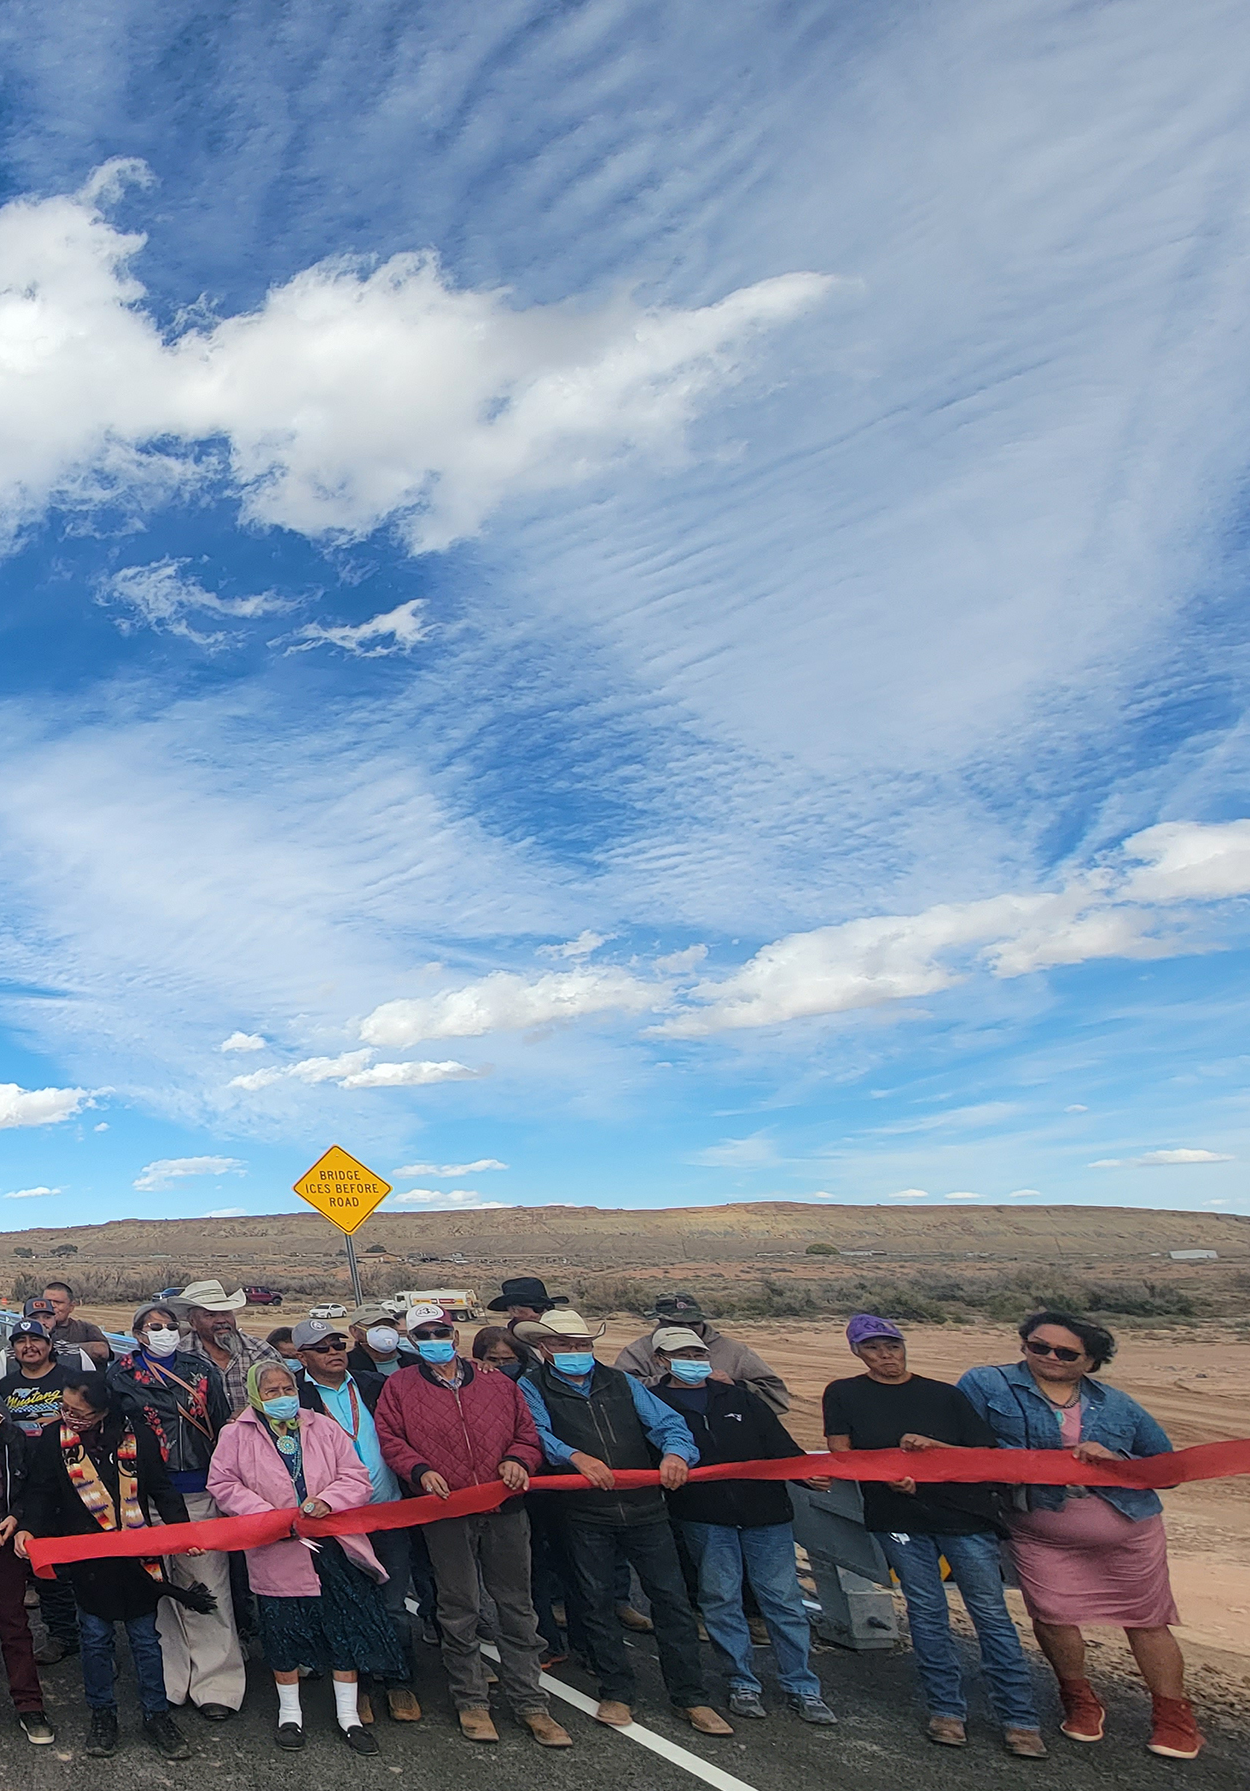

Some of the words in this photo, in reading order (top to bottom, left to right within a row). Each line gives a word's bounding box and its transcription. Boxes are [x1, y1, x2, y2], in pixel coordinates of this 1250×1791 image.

[319, 1170, 361, 1181] BRIDGE
[305, 1183, 331, 1194] ICES
[335, 1183, 379, 1194] BEFORE
[329, 1197, 359, 1207] ROAD
[5, 1389, 64, 1409] Mustang
